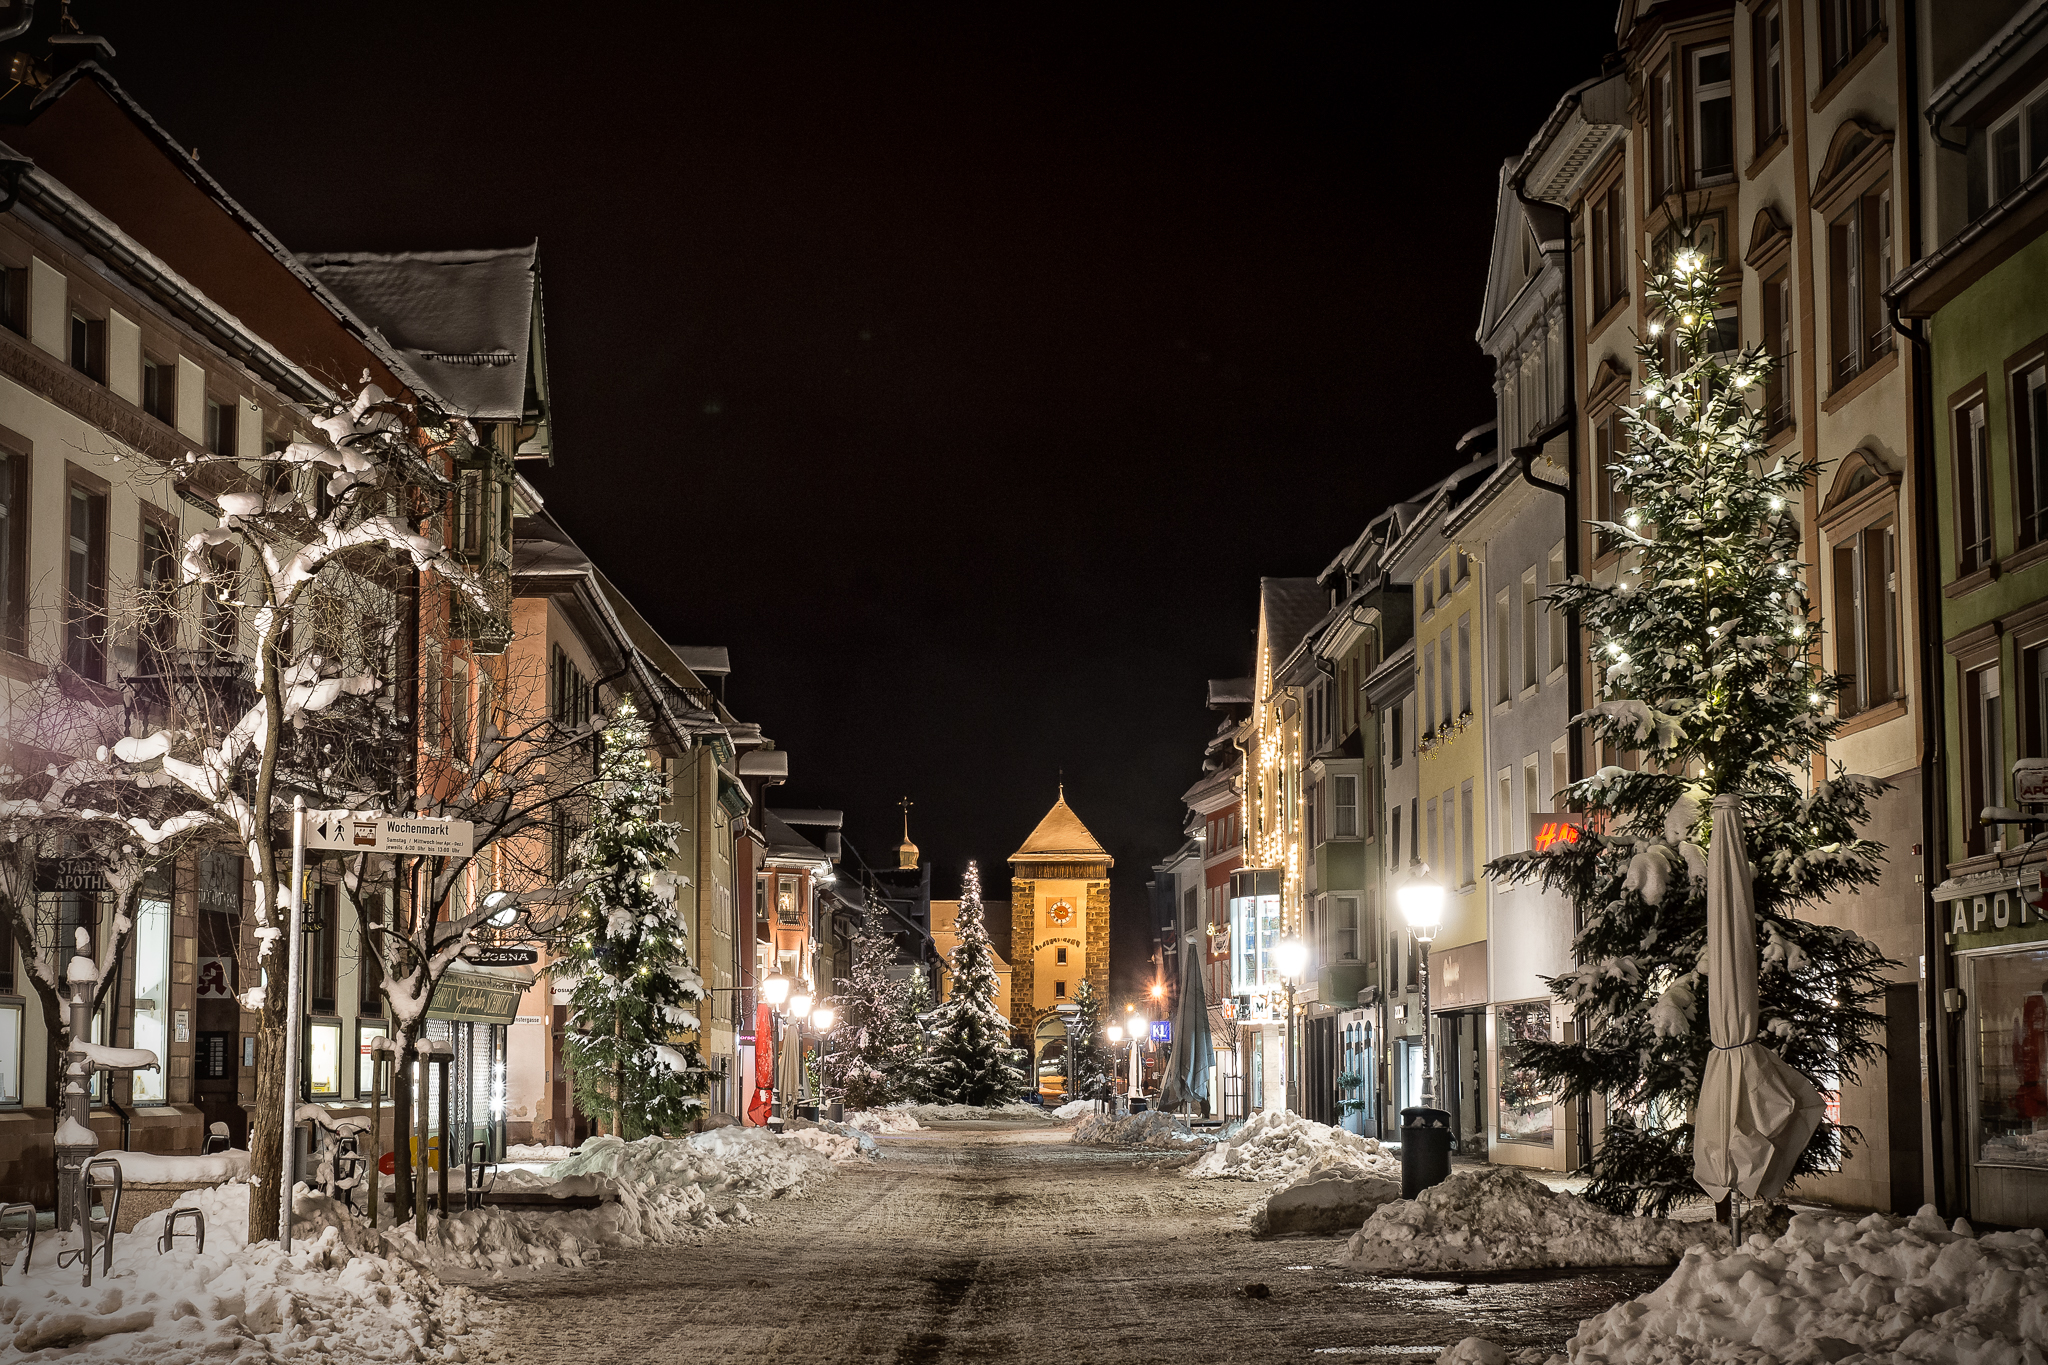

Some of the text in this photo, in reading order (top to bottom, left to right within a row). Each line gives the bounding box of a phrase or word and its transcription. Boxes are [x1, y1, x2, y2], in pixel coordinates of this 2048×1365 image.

[387, 821, 449, 836] Wochenmarkt
[386, 837, 407, 845] Samstag
[54, 875, 110, 890] APOTHE
[515, 1017, 540, 1025] nstergasse
